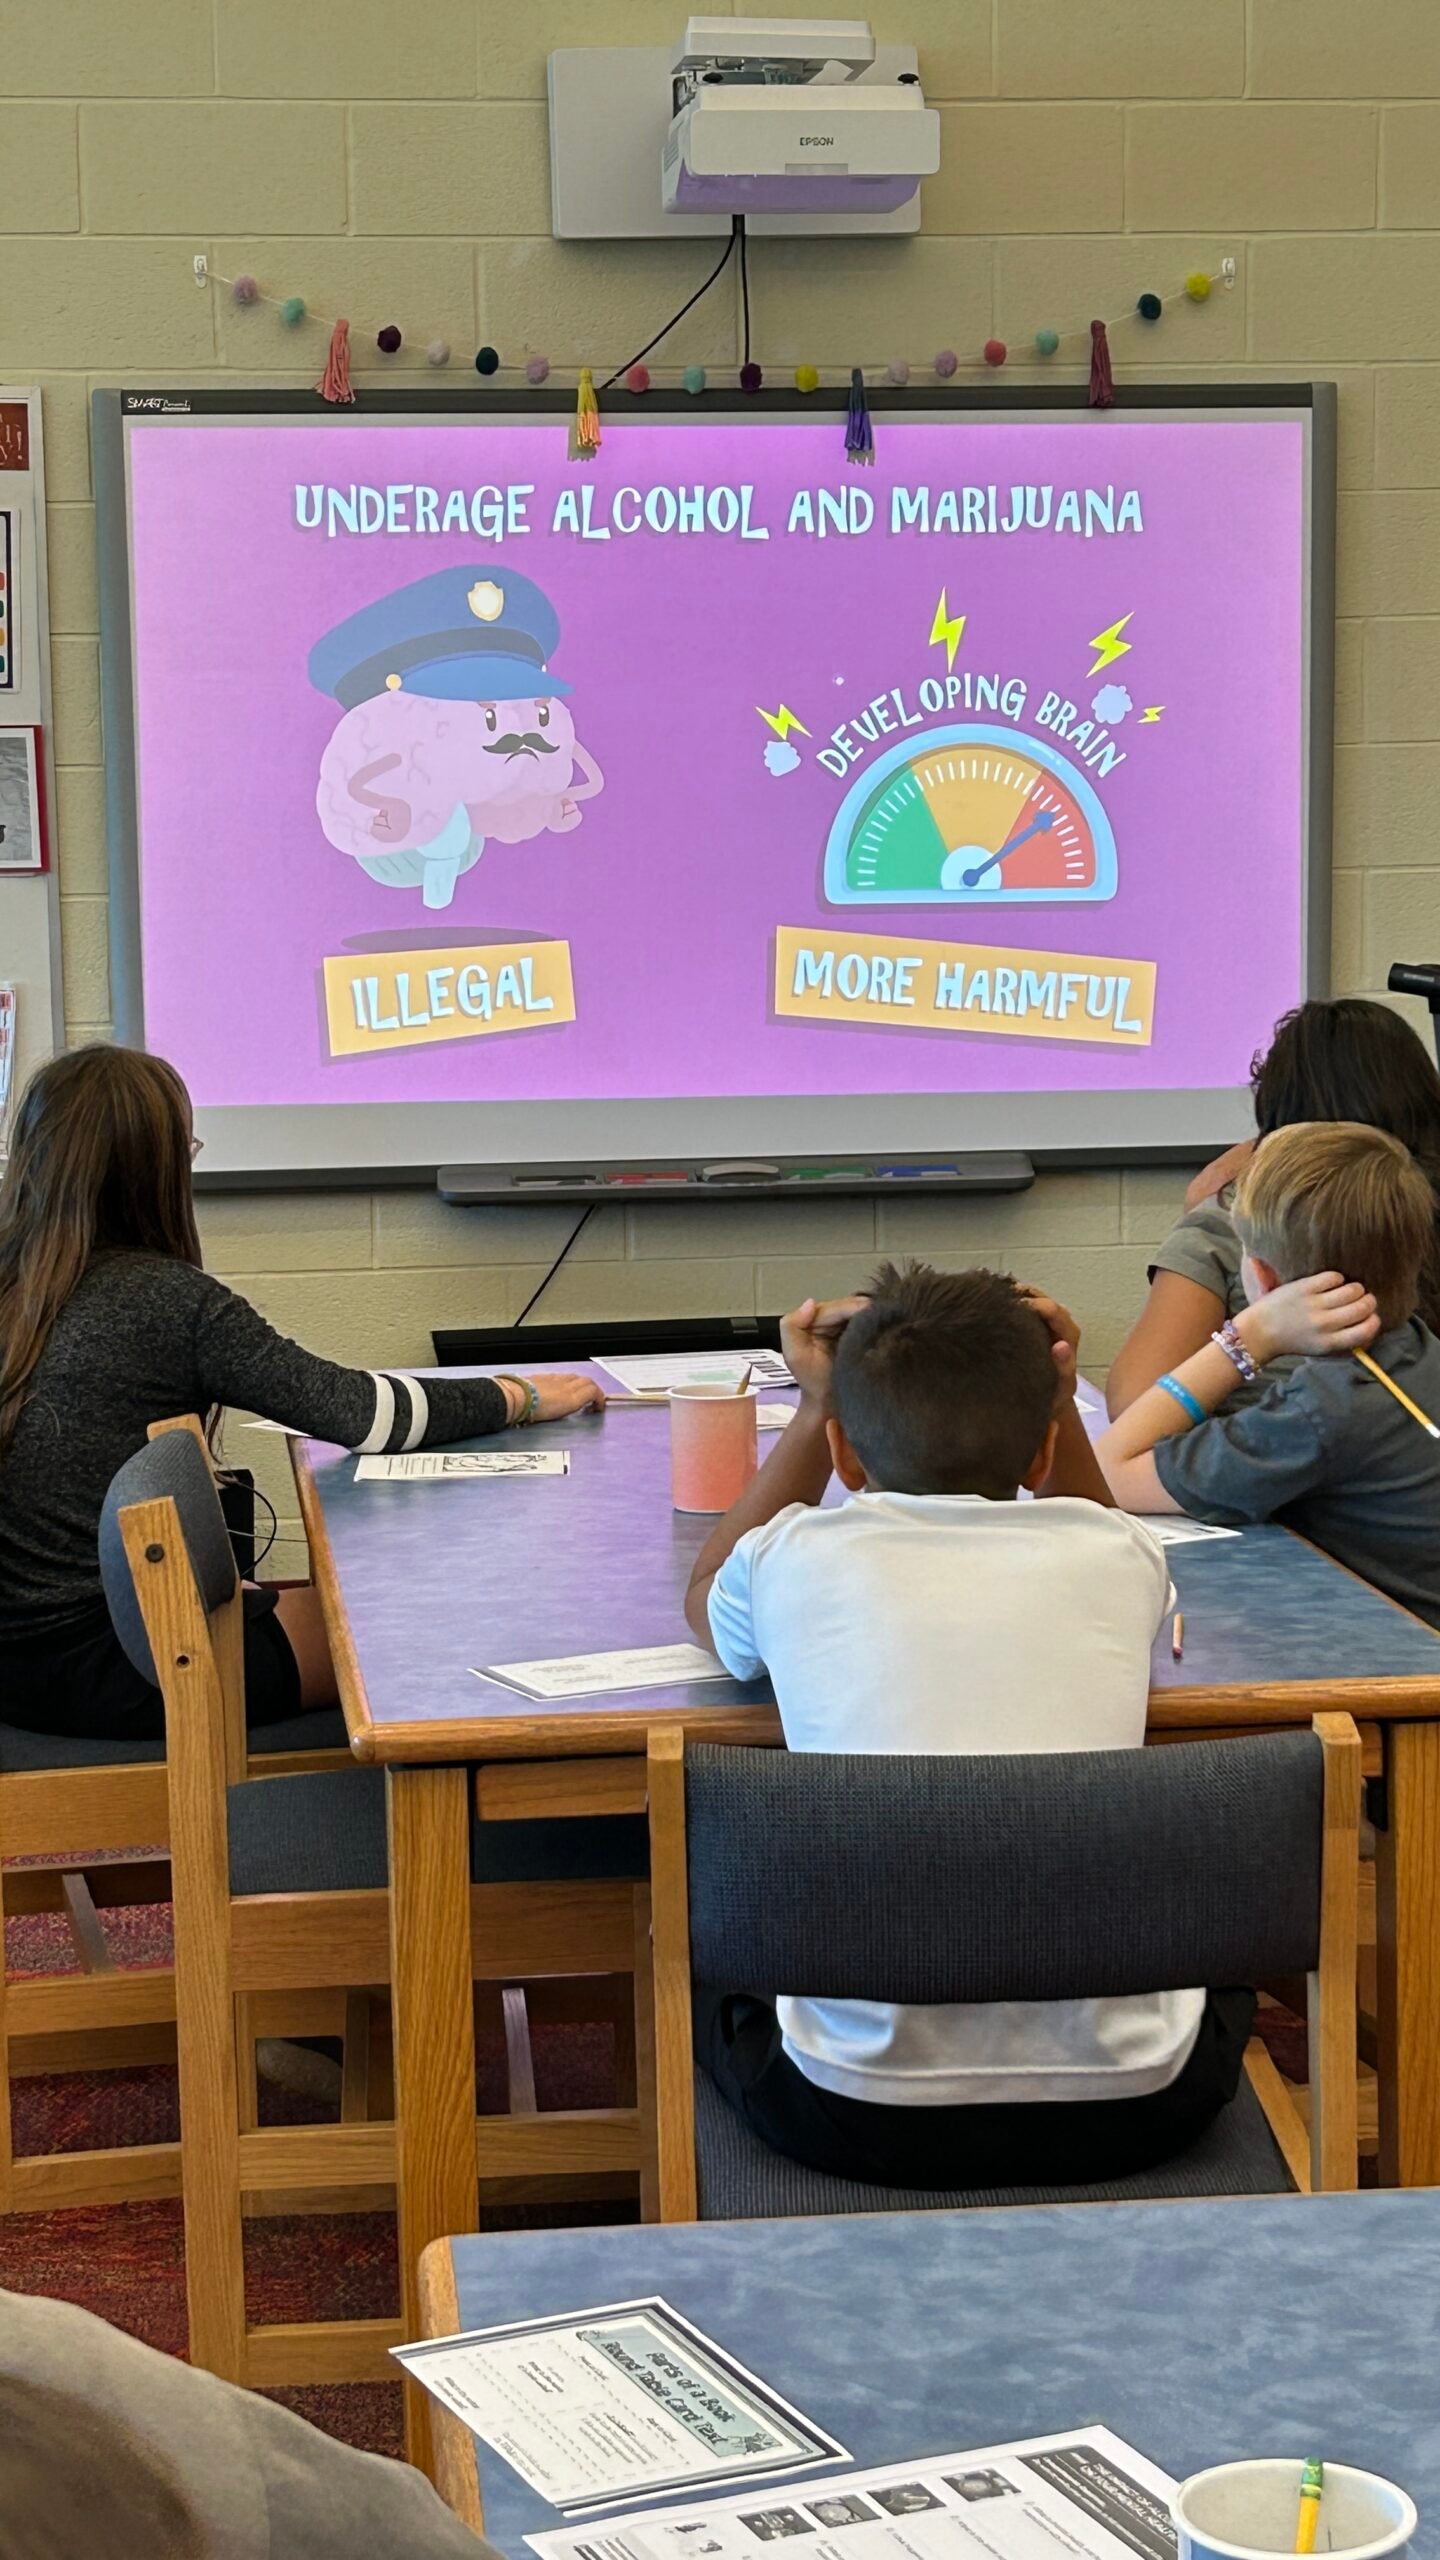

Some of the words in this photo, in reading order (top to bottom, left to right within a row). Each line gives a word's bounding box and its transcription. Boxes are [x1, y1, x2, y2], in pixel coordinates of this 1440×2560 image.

[799, 136, 834, 146] EPSON
[127, 397, 163, 408] SMART
[294, 483, 534, 542] UNDERAGE
[552, 484, 769, 540] ALCOHOL
[787, 485, 874, 538] AND
[891, 485, 1144, 538] MARIJUANA
[816, 673, 1027, 778] DEVELOPING
[1034, 691, 1127, 778] BRAIN
[351, 957, 554, 1030] ILLEGAL
[793, 949, 923, 1005] MORE
[934, 962, 1142, 1032] HARMFUL
[601, 2341, 645, 2371] Round
[635, 2370, 671, 2397] Table
[665, 2398, 703, 2423] Card
[646, 2352, 683, 2378] Parts
[677, 2379, 700, 2391] of
[690, 2390, 706, 2398] a
[699, 2398, 736, 2423] Book
